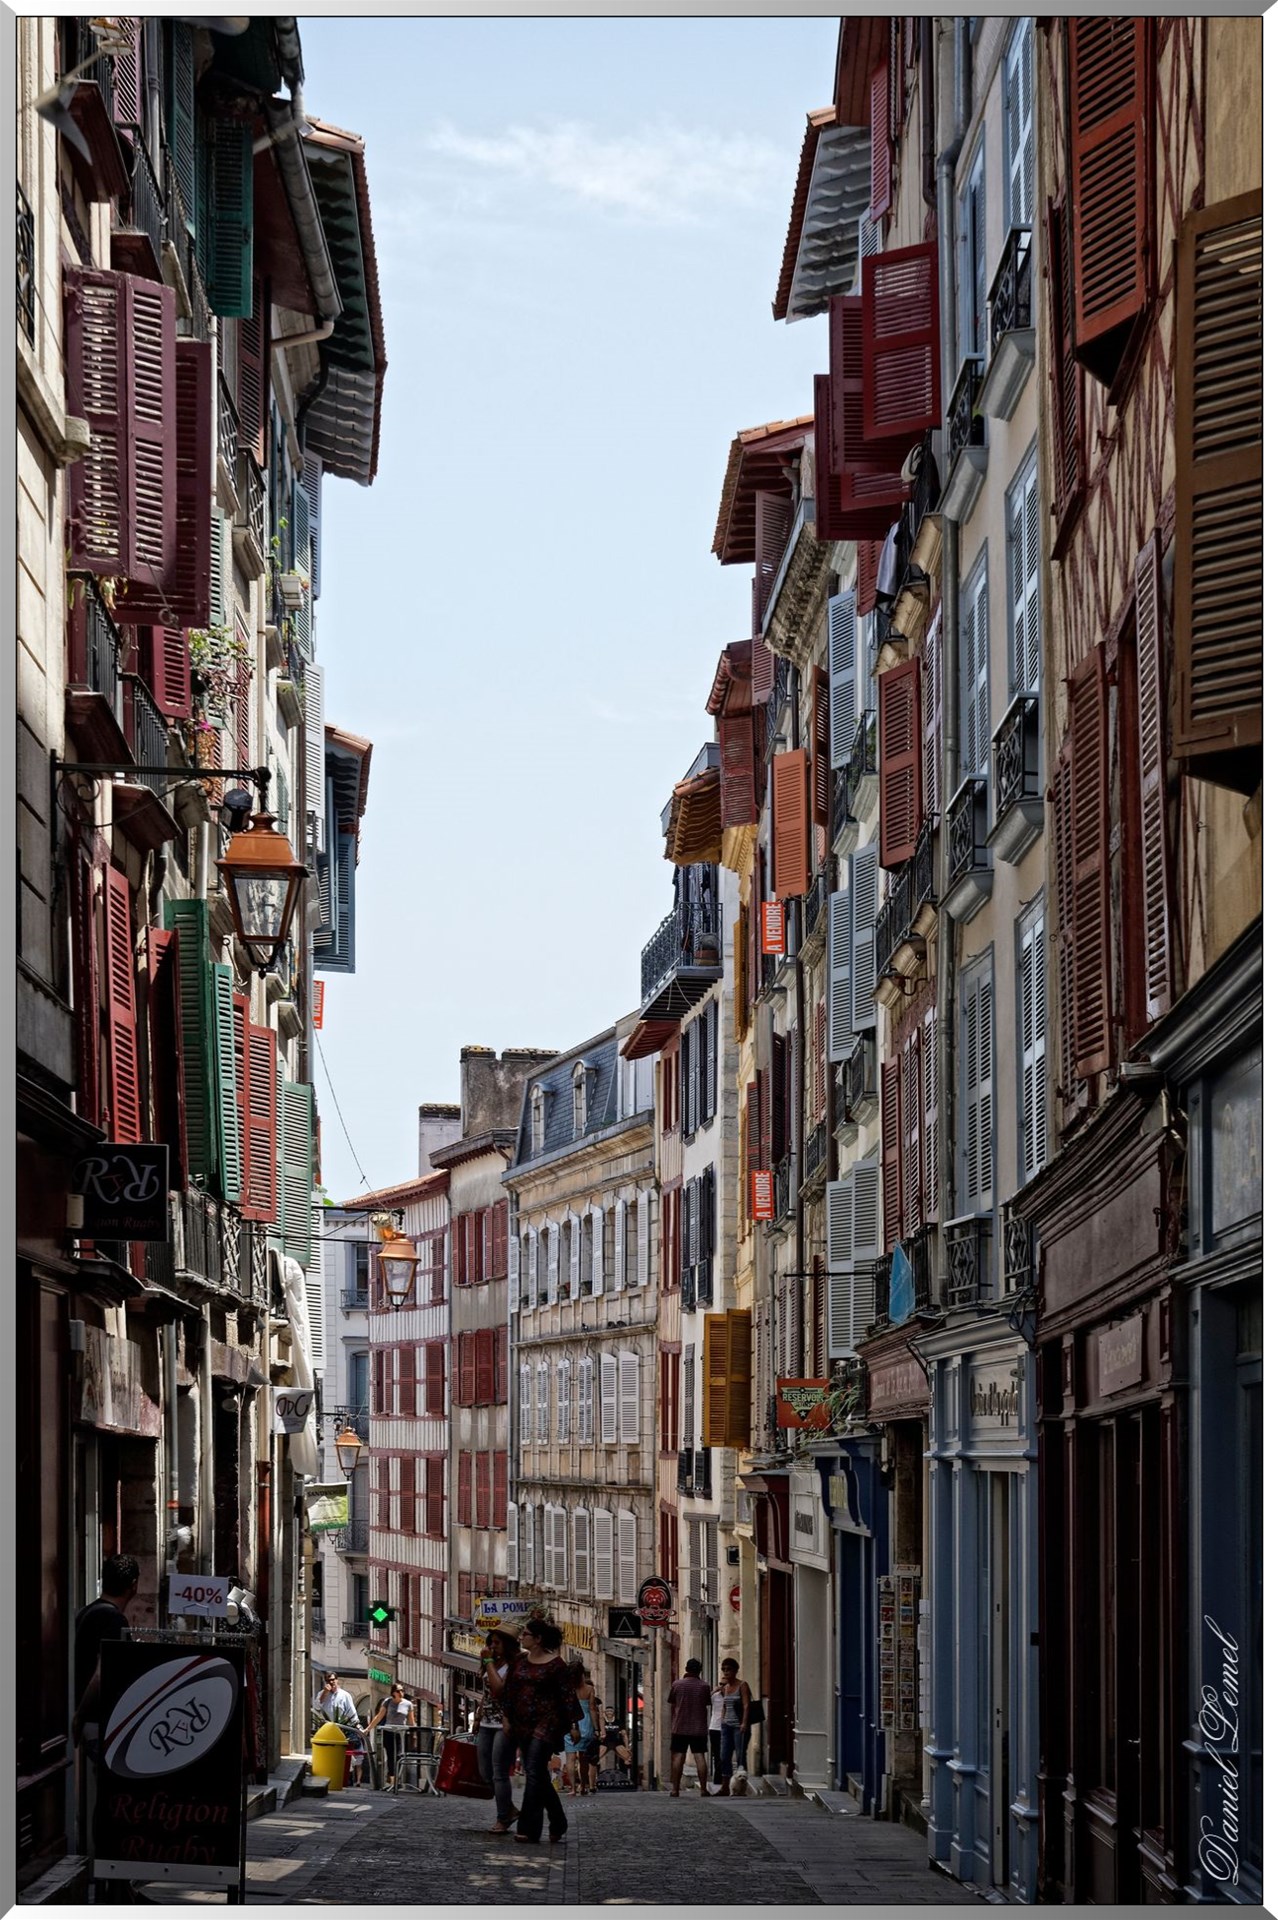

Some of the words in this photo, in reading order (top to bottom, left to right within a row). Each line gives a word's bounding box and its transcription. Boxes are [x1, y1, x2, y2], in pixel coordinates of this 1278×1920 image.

[766, 903, 782, 941] VENDRE
[755, 1173, 771, 1208] VENDRE
[175, 1586, 223, 1604] -40%
[484, 1603, 498, 1614] LA
[111, 1790, 229, 1832] Religion
[121, 1835, 217, 1865] Rugby
